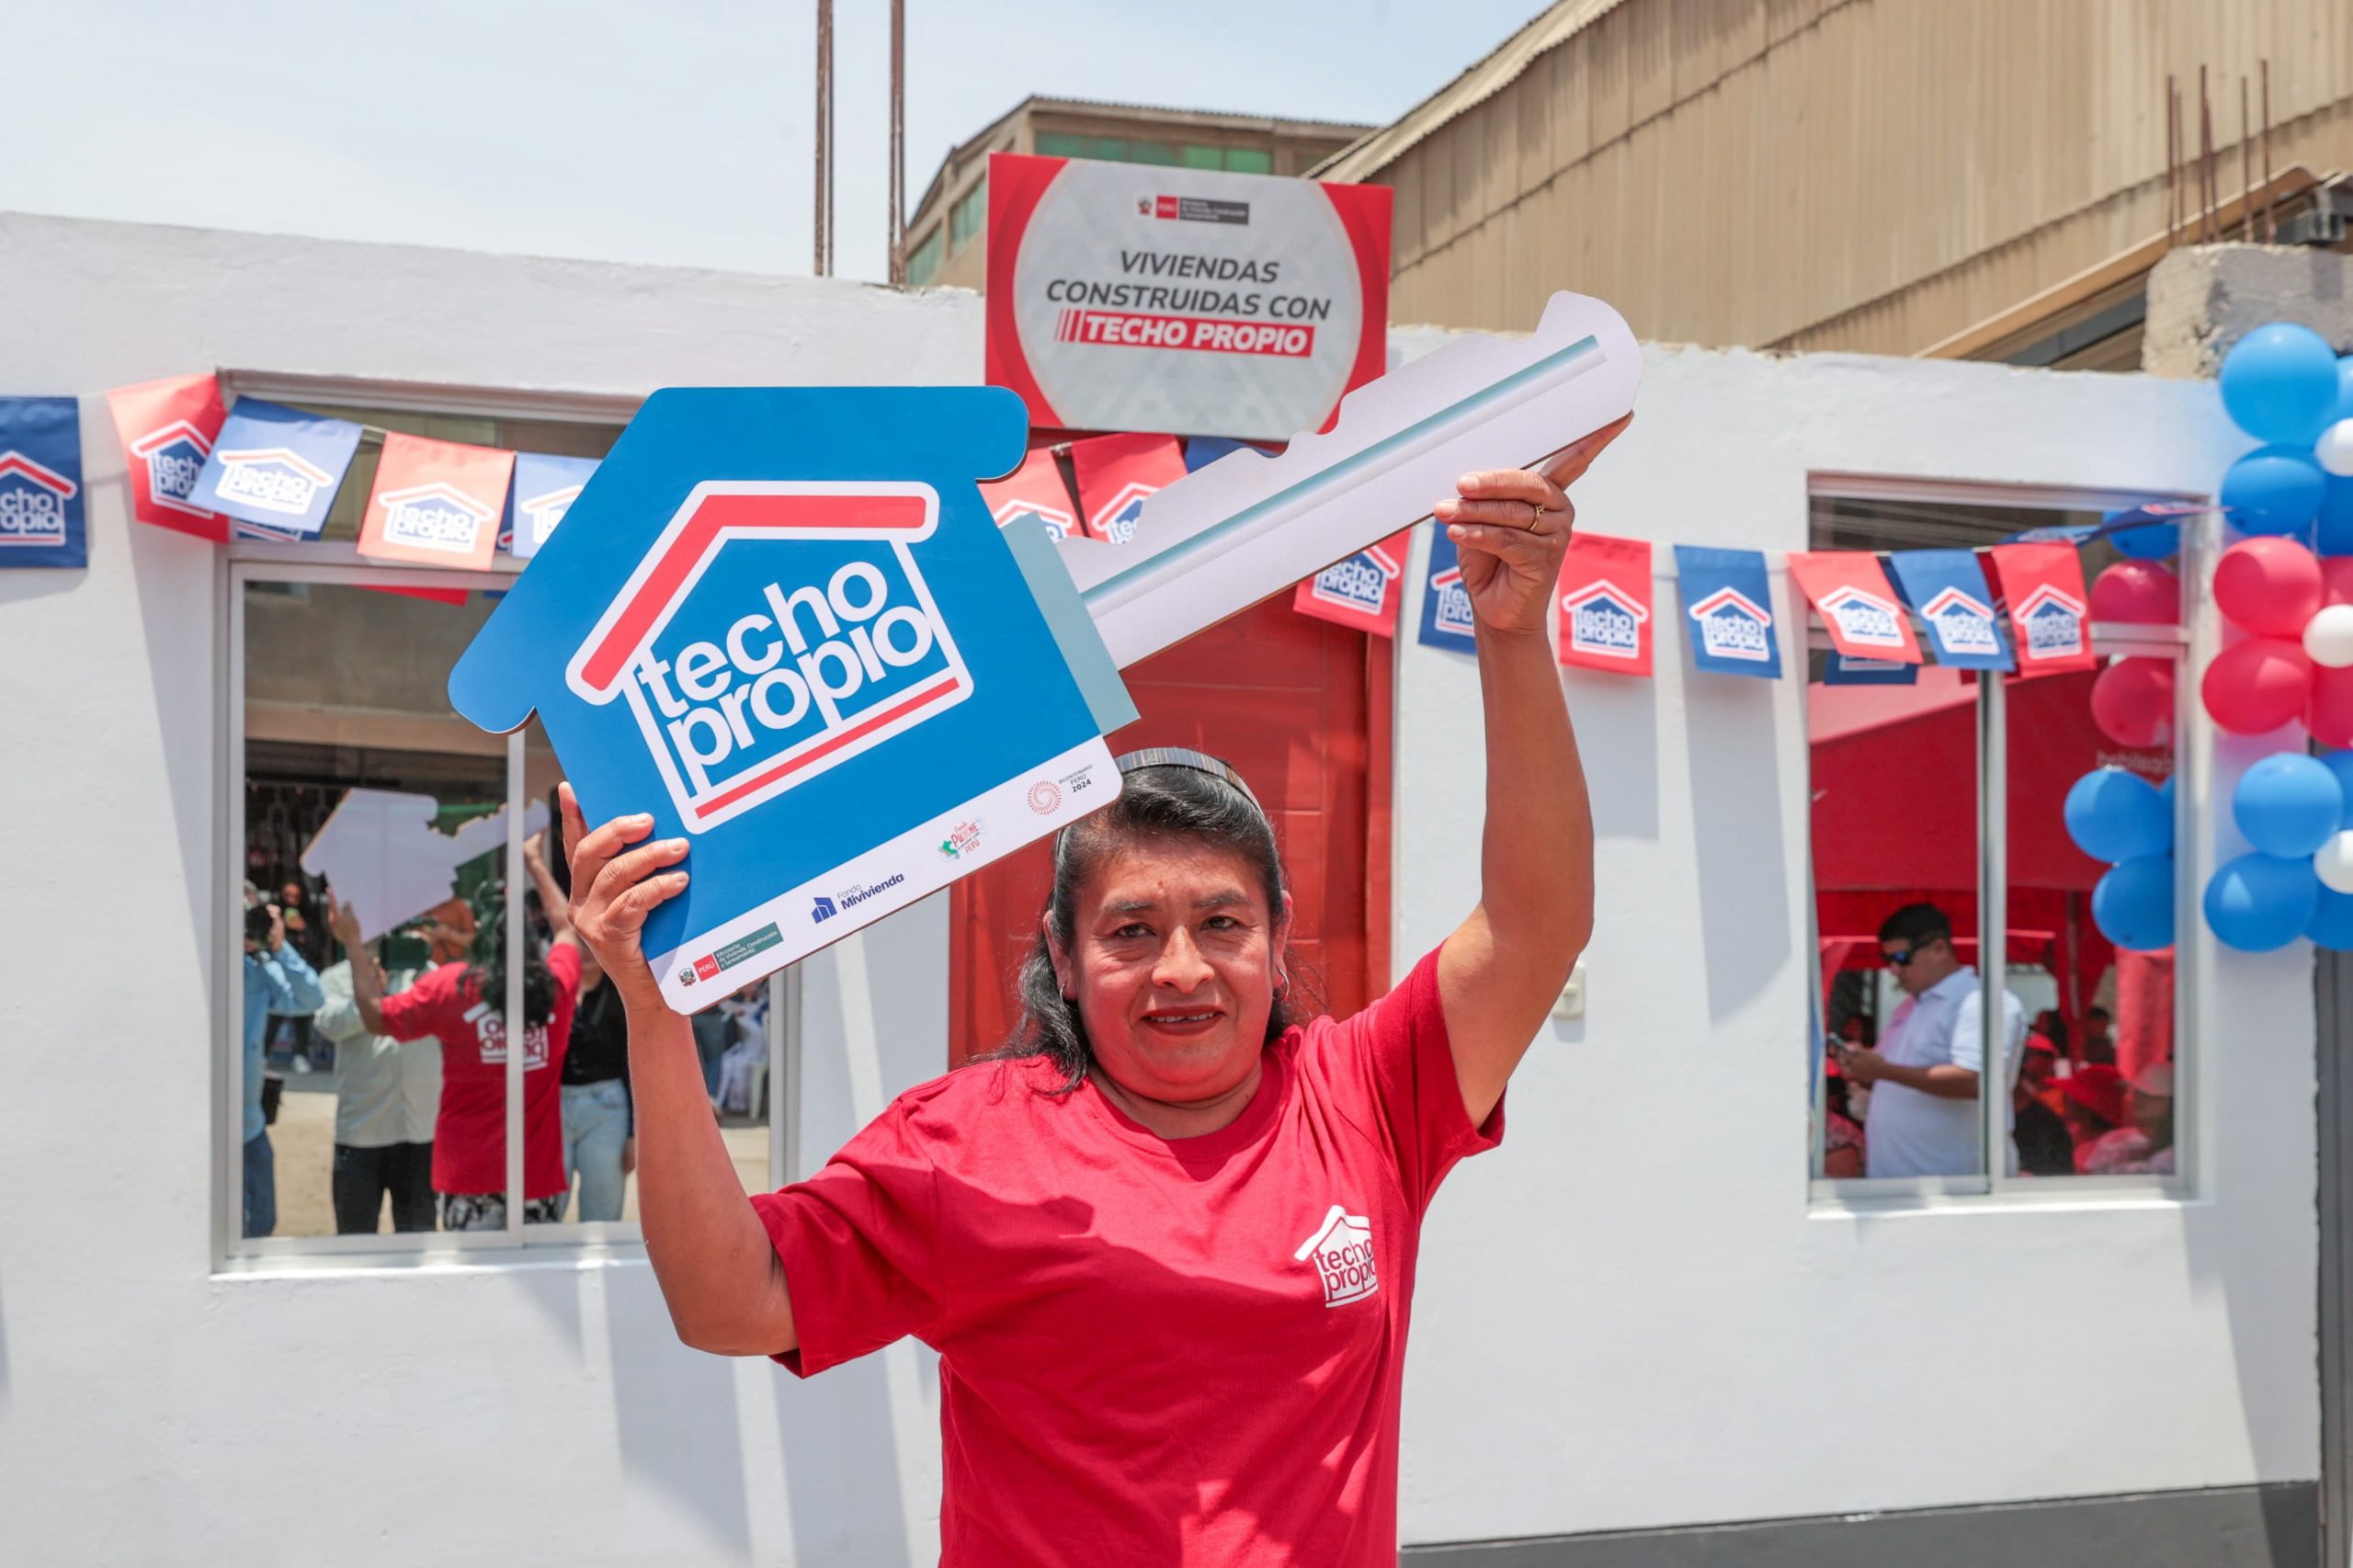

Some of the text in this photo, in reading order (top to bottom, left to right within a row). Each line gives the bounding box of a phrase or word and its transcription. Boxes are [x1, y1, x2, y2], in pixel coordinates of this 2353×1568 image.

[1120, 251, 1279, 283] VIVIENDAS
[1047, 279, 1331, 320] CONSTRUIDAS CON
[1086, 315, 1308, 355] TECHO PROPIO
[1320, 572, 1381, 600] propio
[638, 561, 888, 718] techo
[666, 606, 933, 797] propio
[1072, 778, 1092, 793] 2024
[836, 883, 862, 900] Fondo
[840, 873, 904, 910] Mivivienda
[746, 930, 779, 949] Construcción
[699, 961, 714, 974] PERÚ
[724, 948, 756, 966] Saneamiento
[1315, 1239, 1373, 1272] techo
